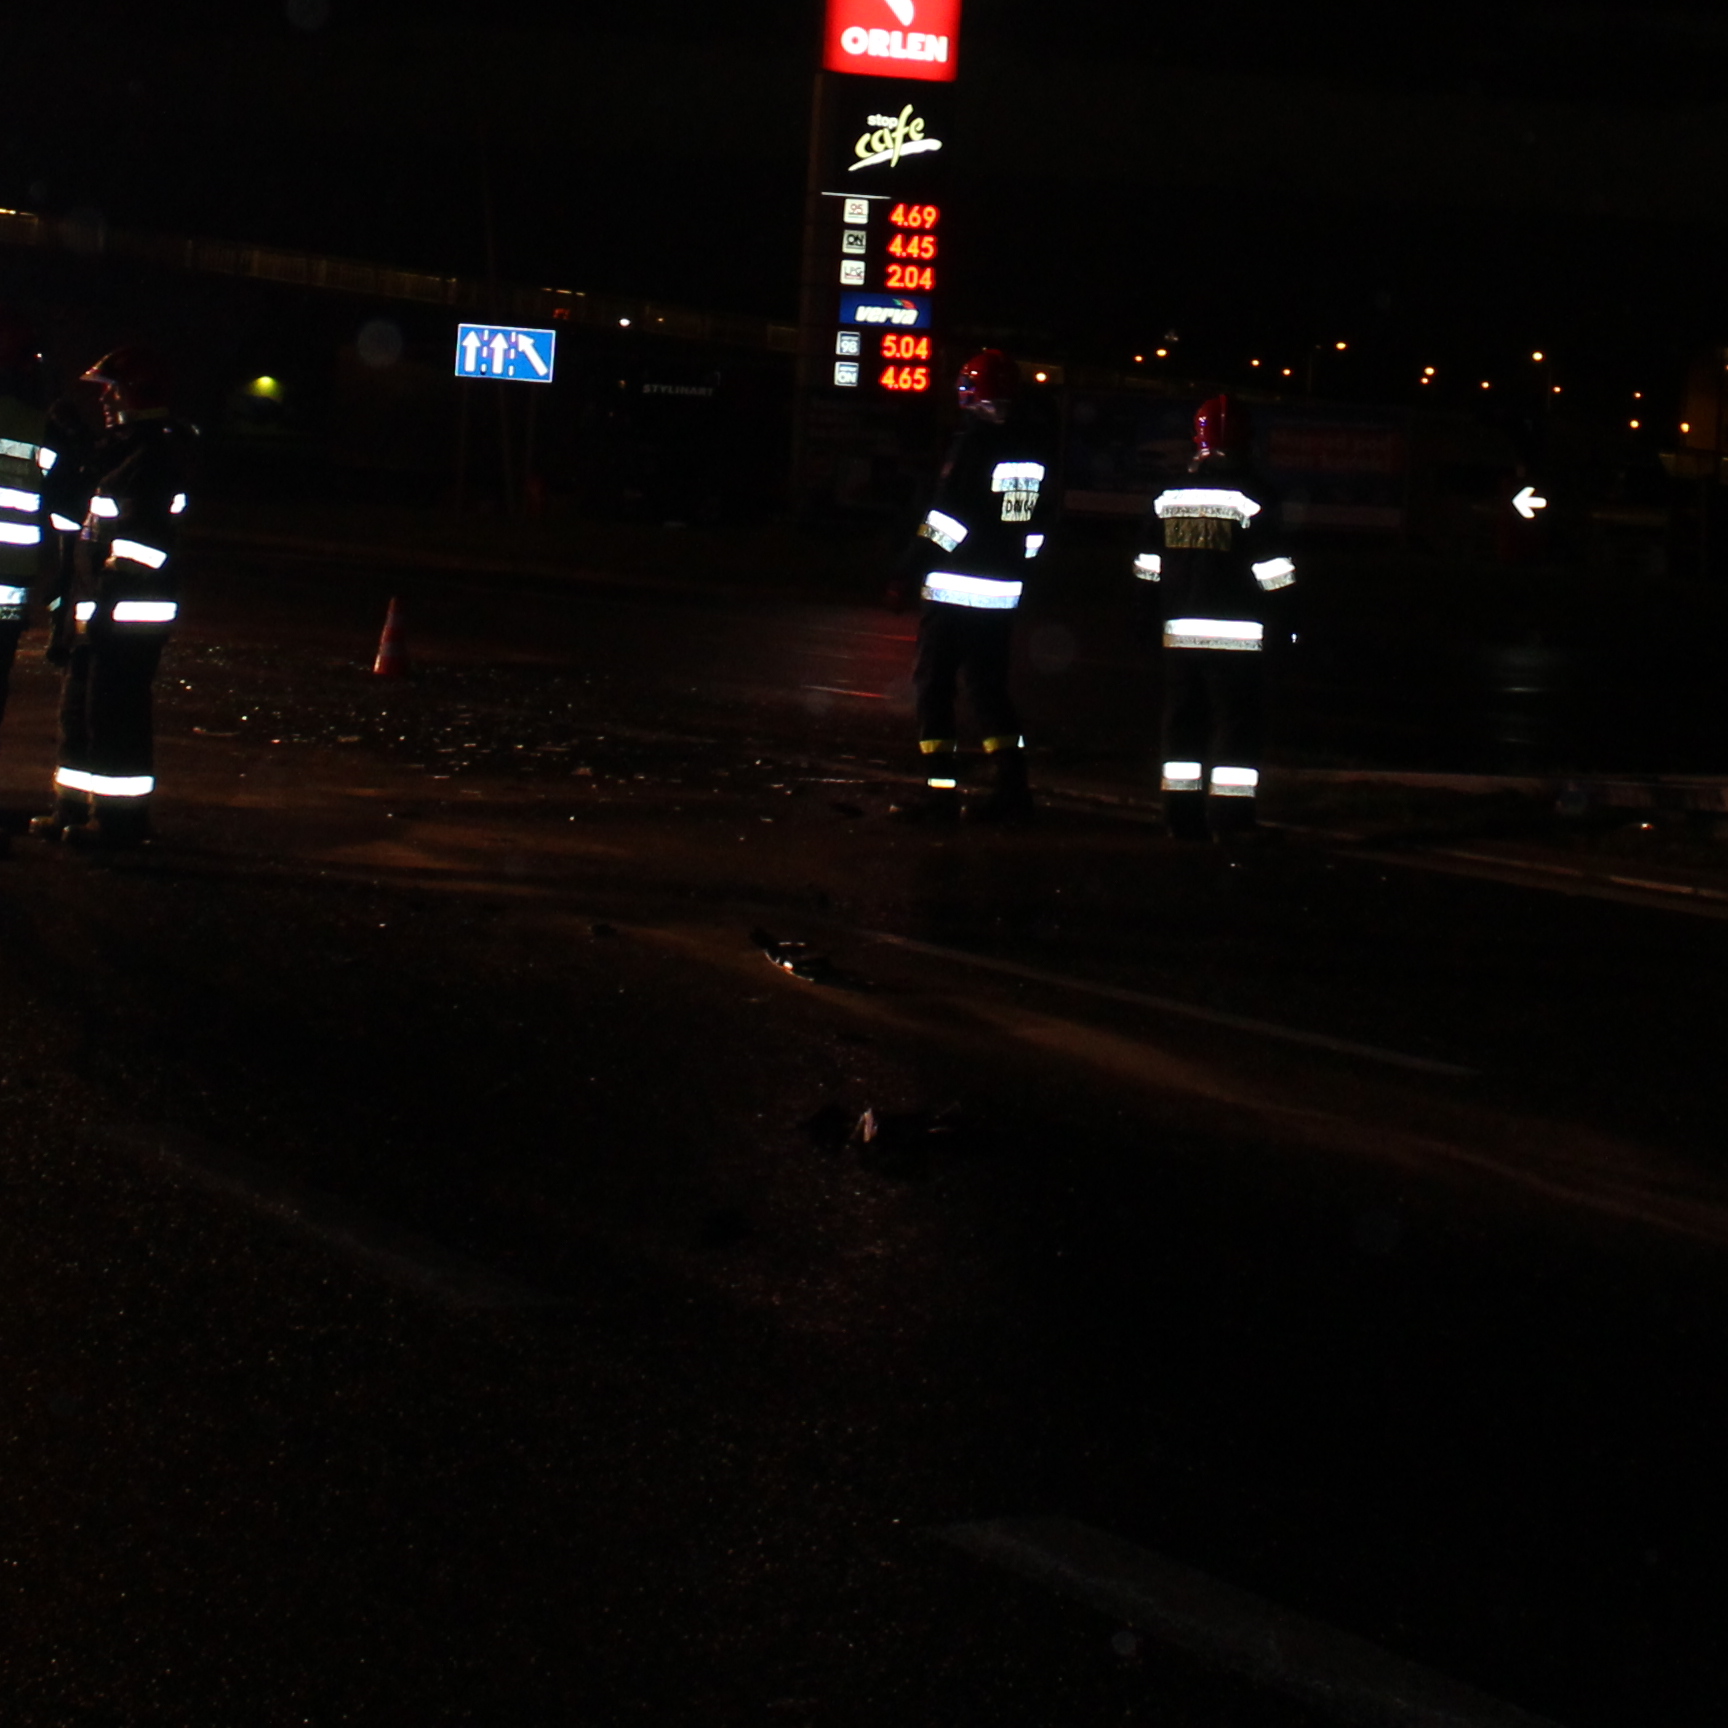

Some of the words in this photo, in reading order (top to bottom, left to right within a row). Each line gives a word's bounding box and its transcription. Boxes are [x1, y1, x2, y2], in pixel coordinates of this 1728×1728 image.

[841, 26, 949, 63] ORLEN
[867, 114, 898, 130] stop
[855, 104, 925, 167] cafe
[890, 203, 937, 229] 4.69
[846, 234, 864, 247] ON
[888, 234, 935, 259] 4.45
[886, 264, 932, 289] 2.04
[855, 305, 918, 325] verva
[841, 340, 858, 354] 98
[882, 334, 929, 359] 5.04
[837, 371, 857, 384] ON
[880, 366, 927, 390] 4.65
